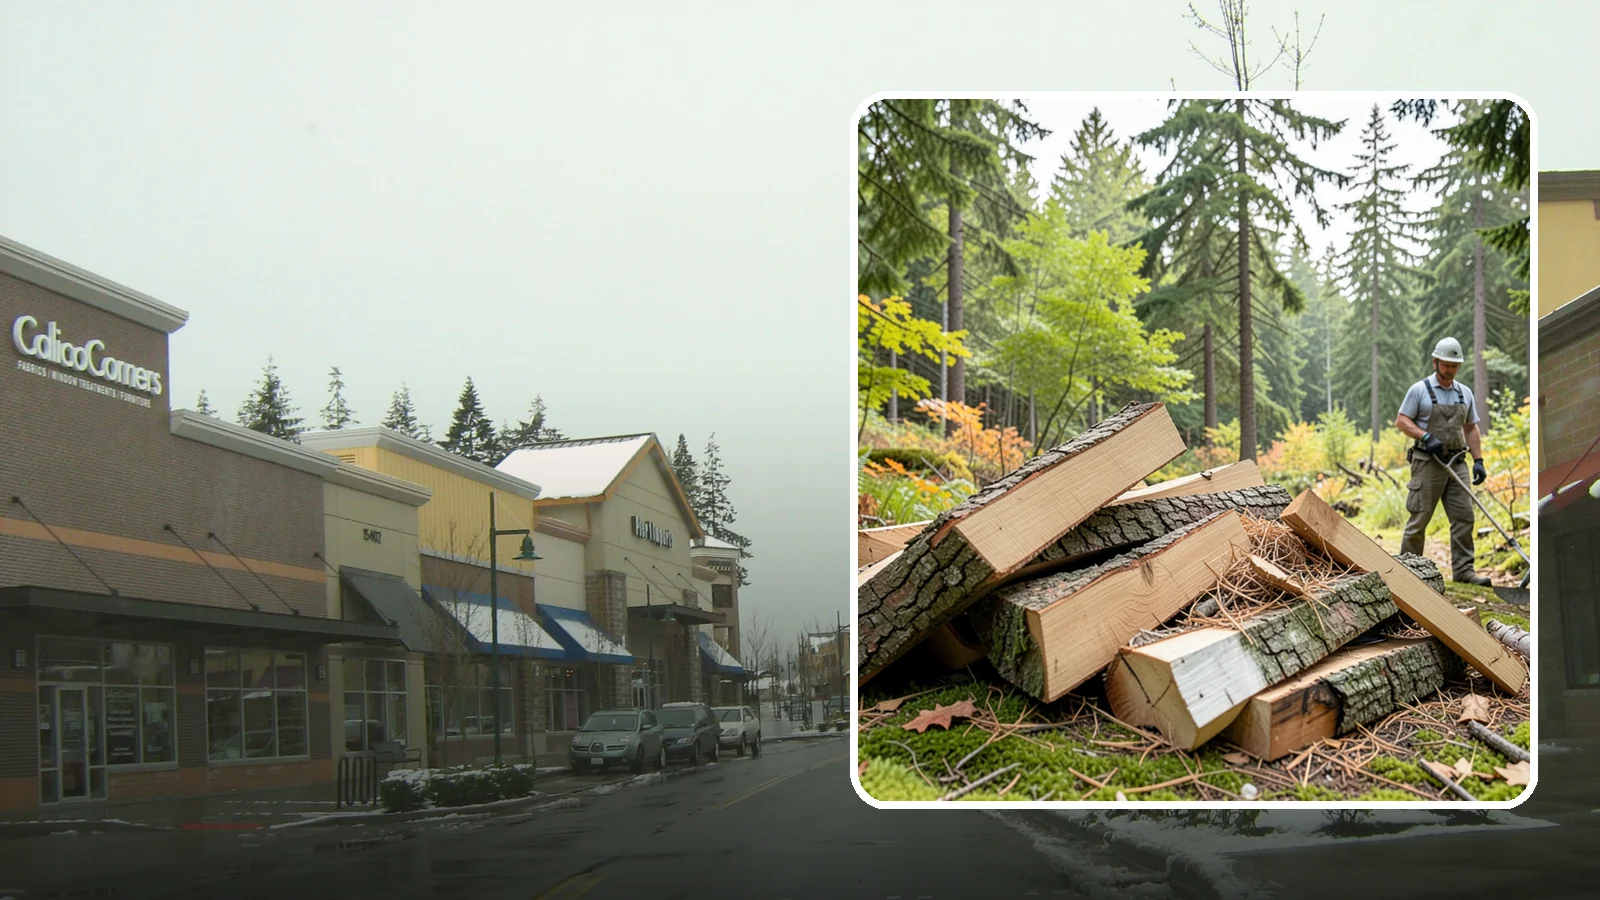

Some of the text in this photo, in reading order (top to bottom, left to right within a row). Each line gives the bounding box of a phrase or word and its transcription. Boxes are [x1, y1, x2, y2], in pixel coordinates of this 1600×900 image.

[17, 360, 151, 409] FABRICS WINDOW TREATMENTS FURNITURE
